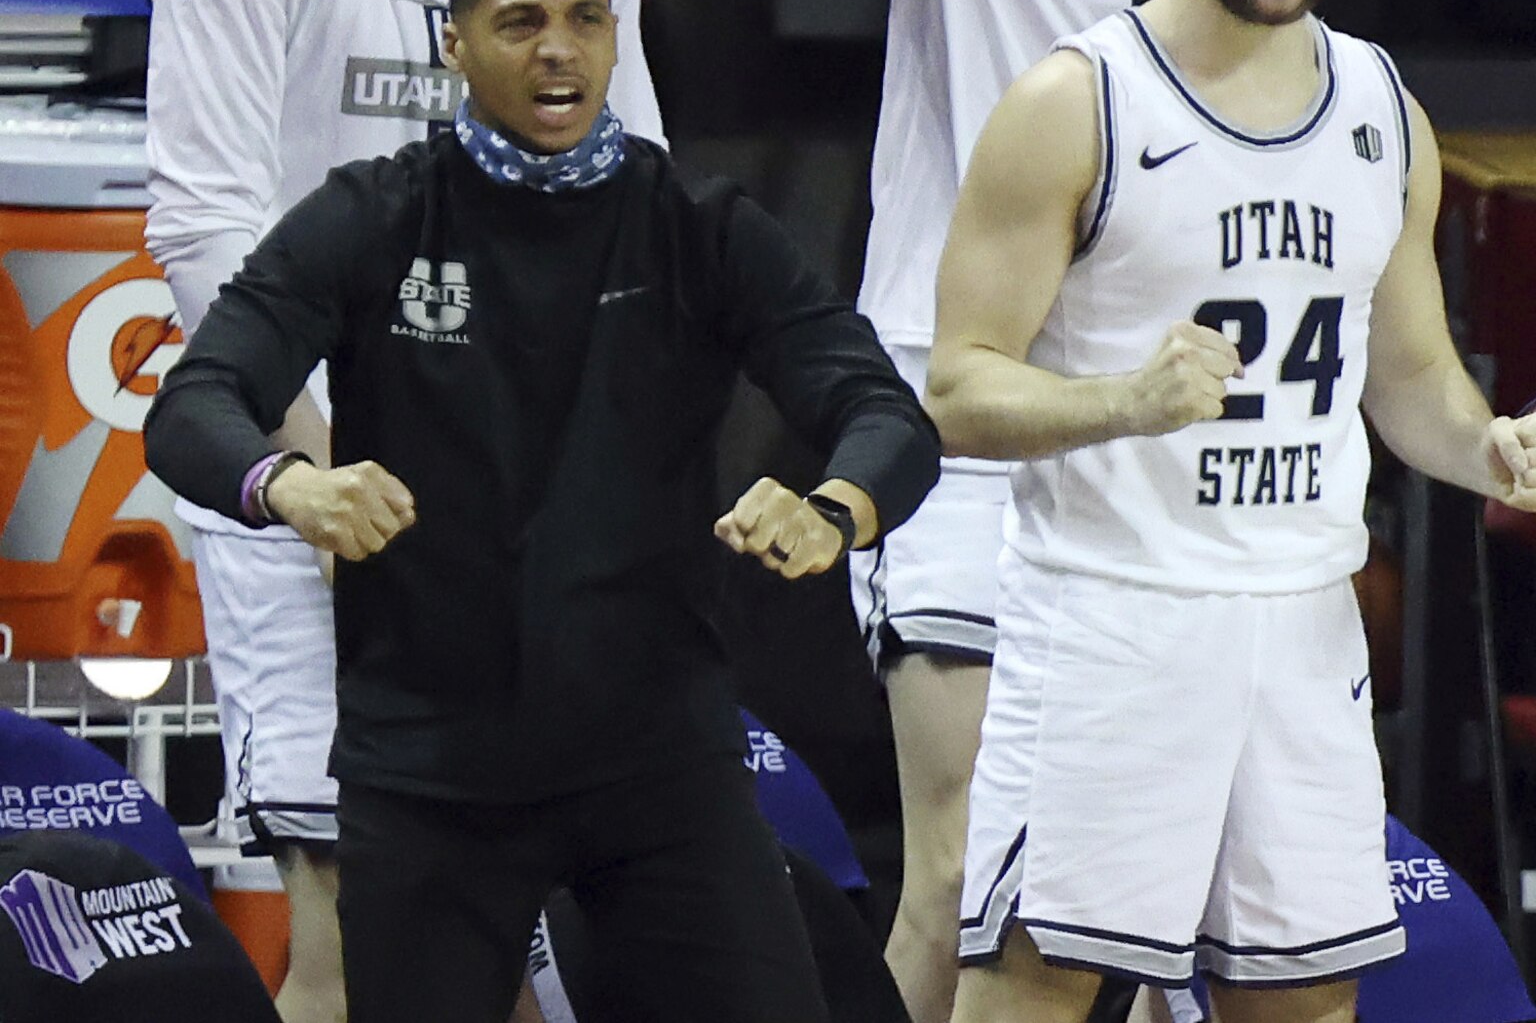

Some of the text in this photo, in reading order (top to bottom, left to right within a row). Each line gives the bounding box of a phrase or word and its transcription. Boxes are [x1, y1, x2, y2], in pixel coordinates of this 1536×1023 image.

[353, 72, 450, 112] UTAH
[1218, 200, 1335, 270] UTAH
[1193, 296, 1345, 421] 24
[1197, 443, 1322, 507] STATE
[31, 779, 144, 806] FORCE
[1386, 858, 1449, 882] RCE
[82, 877, 177, 916] MOUNTAIN
[91, 903, 192, 959] WEST
